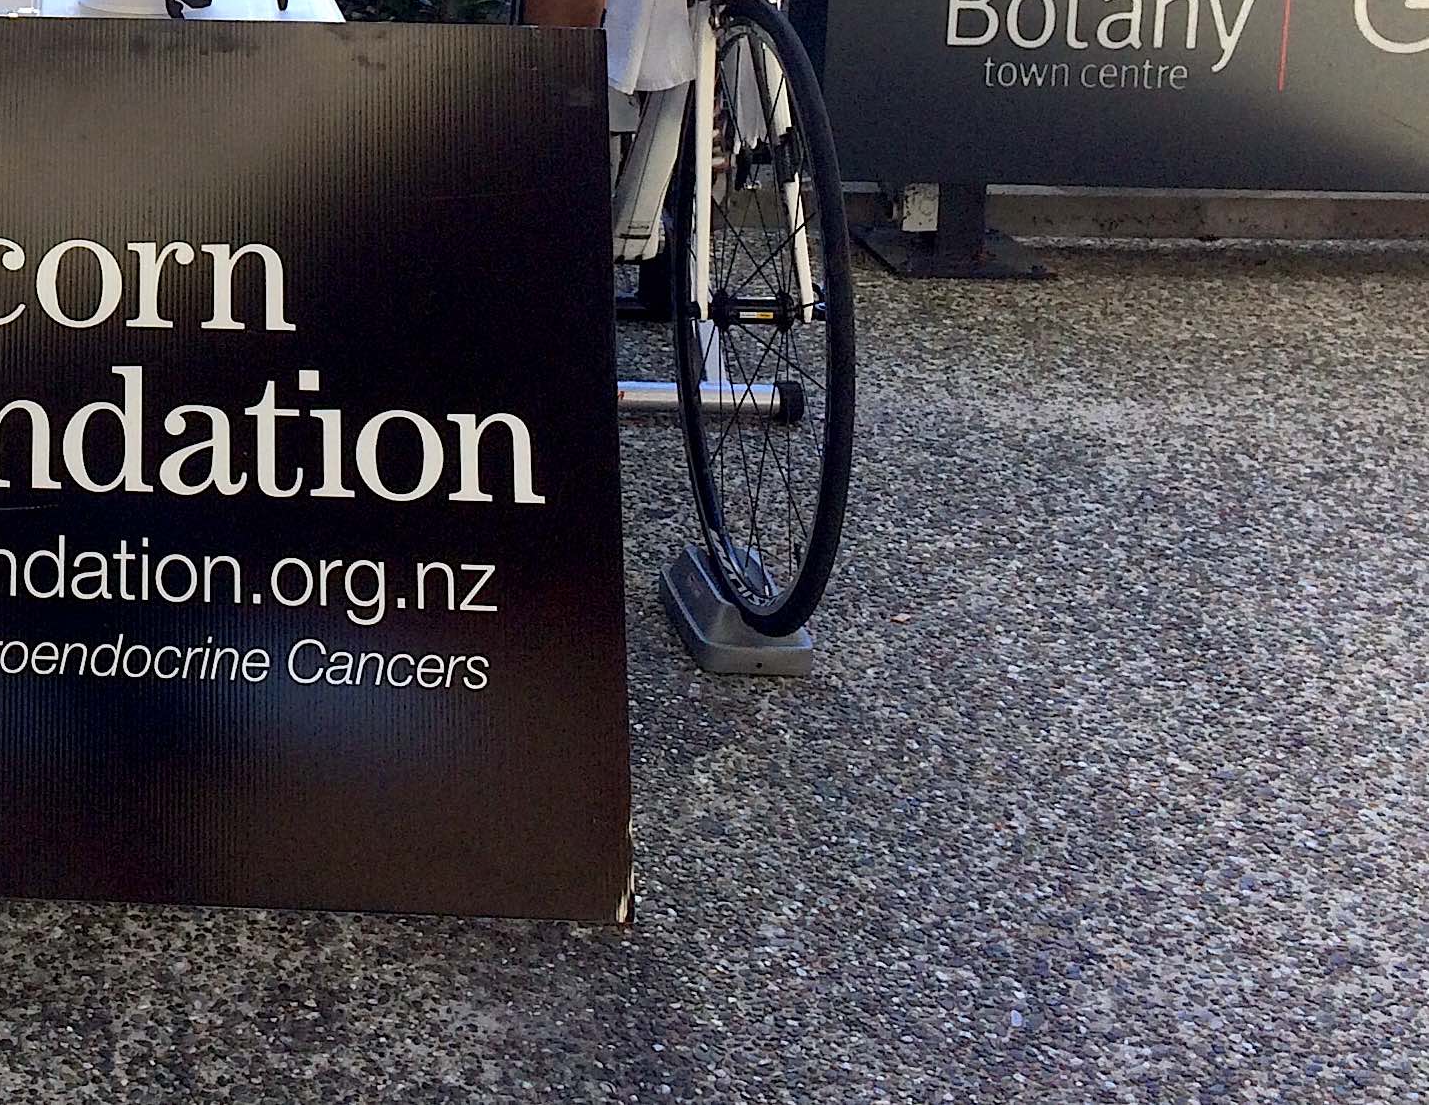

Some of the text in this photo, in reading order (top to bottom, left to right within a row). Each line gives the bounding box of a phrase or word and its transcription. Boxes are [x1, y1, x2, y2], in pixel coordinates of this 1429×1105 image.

[983, 56, 1189, 91] town centre
[287, 637, 490, 690] Cancers
